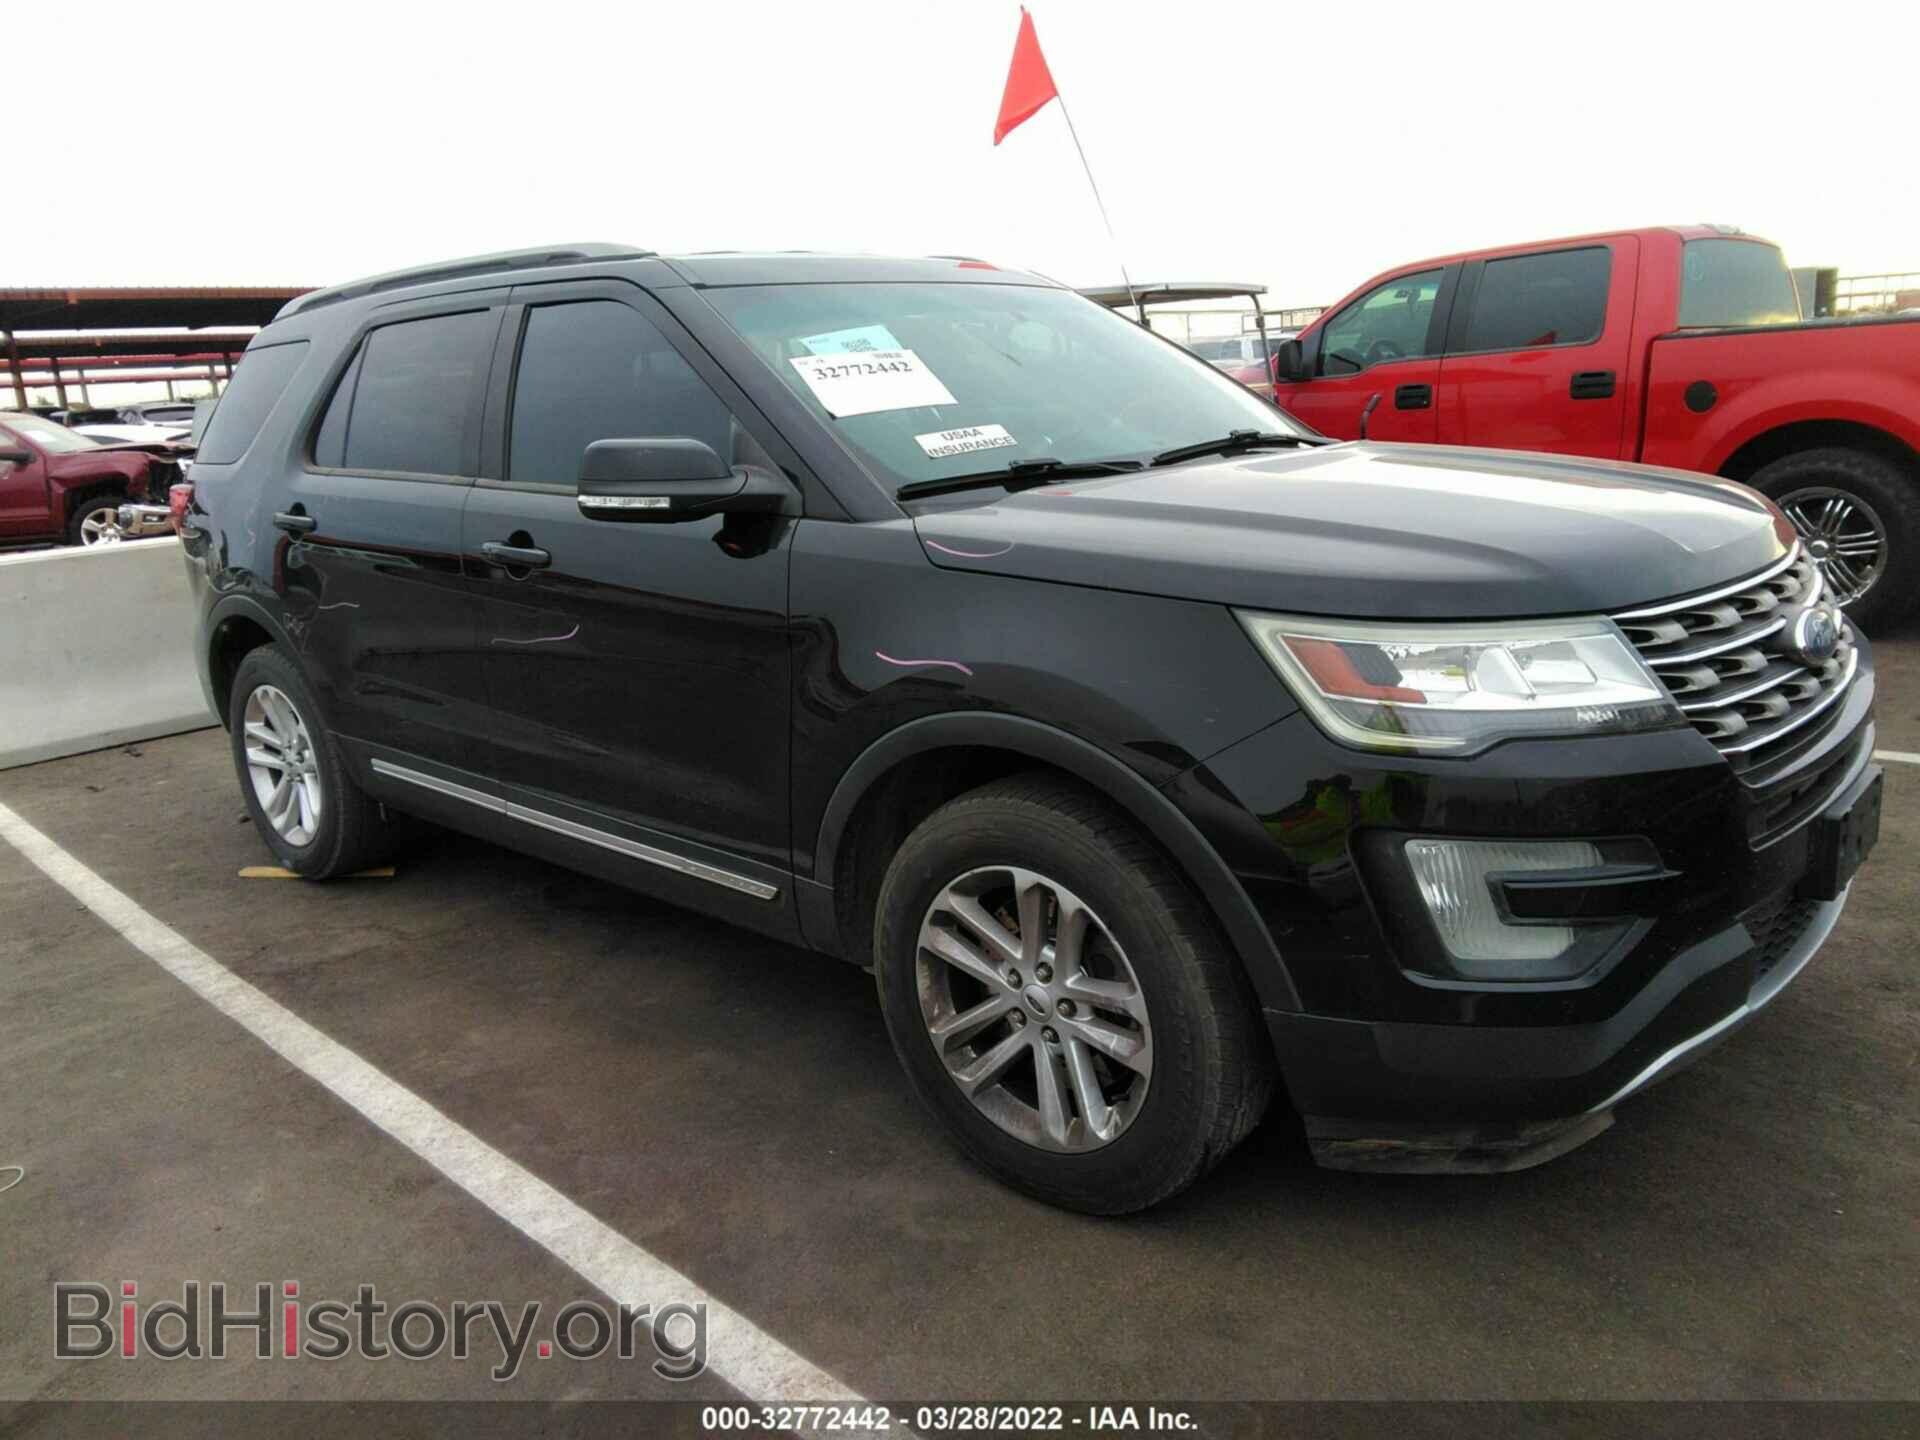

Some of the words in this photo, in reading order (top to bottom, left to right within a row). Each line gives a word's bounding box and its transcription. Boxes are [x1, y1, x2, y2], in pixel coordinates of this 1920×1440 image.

[813, 361, 913, 380] 32772442
[940, 428, 984, 441] USAA
[927, 435, 1014, 456] INSURANCE
